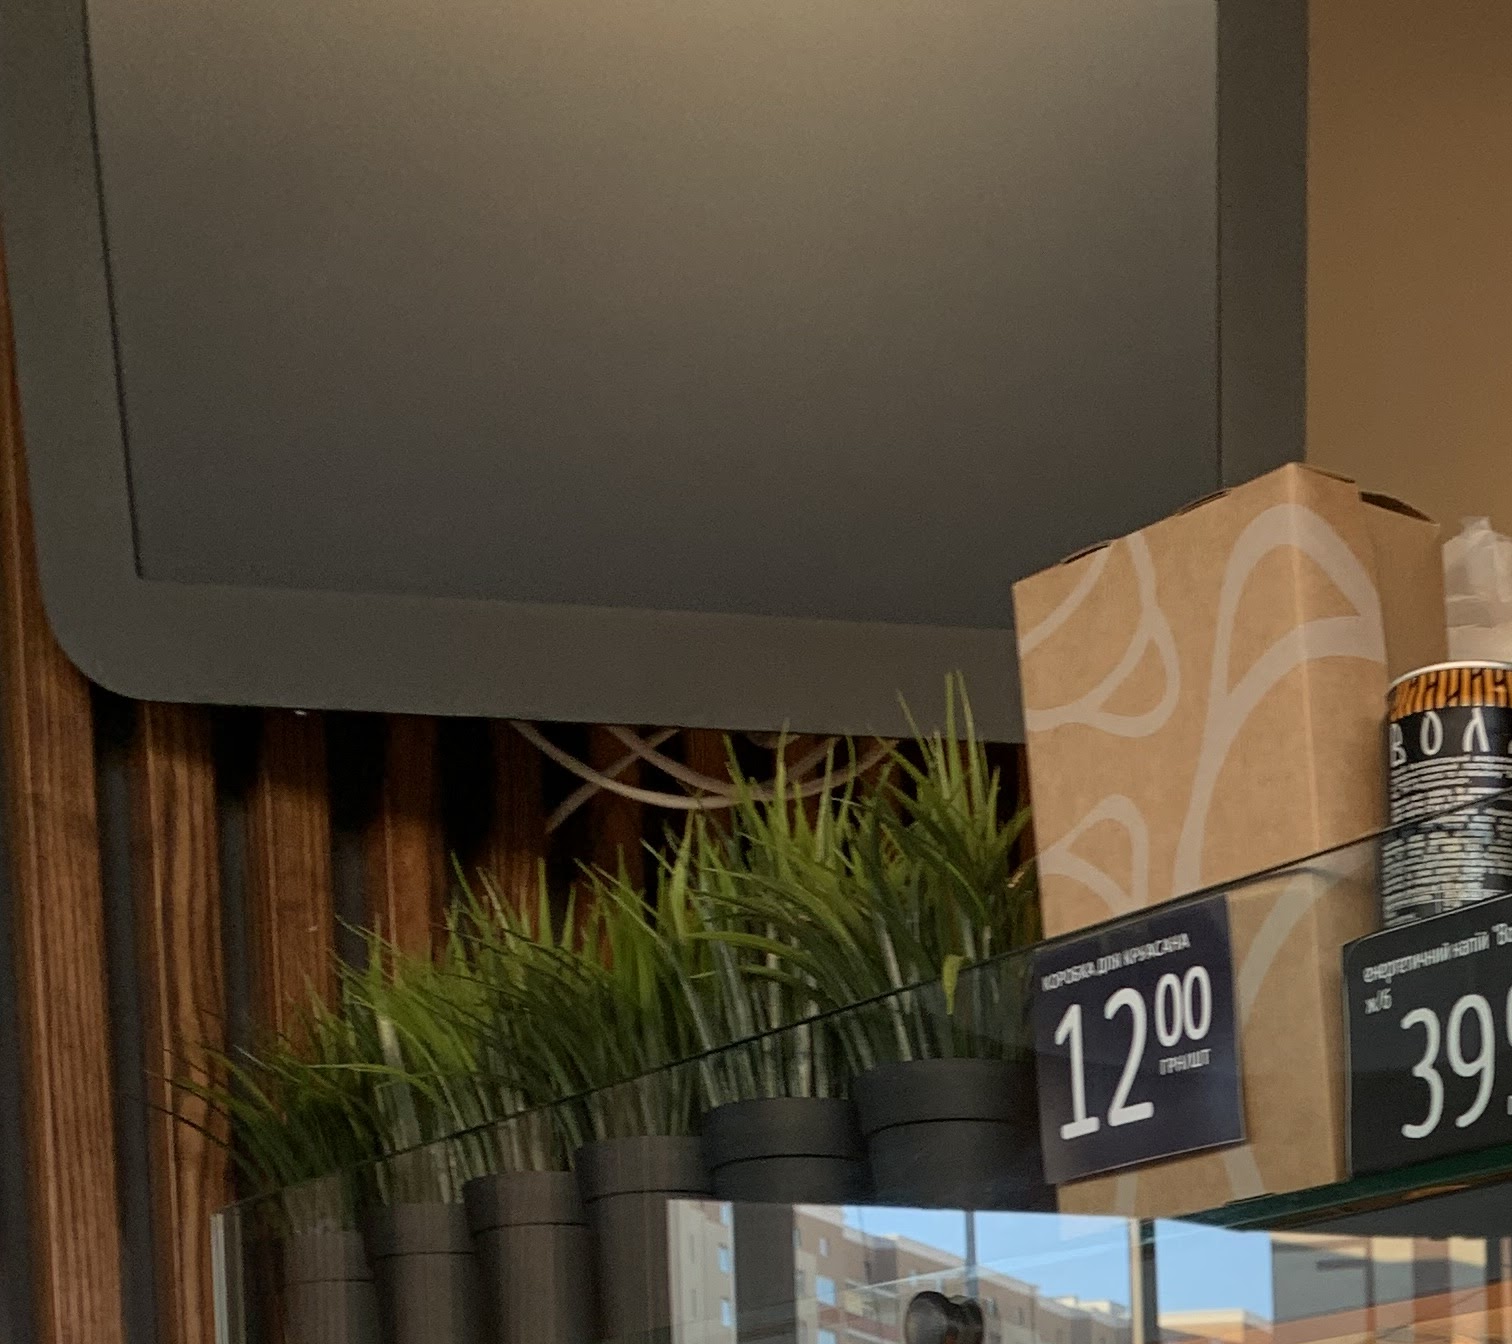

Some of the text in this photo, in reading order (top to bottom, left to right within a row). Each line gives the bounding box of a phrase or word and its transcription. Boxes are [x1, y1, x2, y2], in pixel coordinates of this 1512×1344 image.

[1054, 965, 1212, 1140] 12 00
[1401, 994, 1496, 1139] 39
